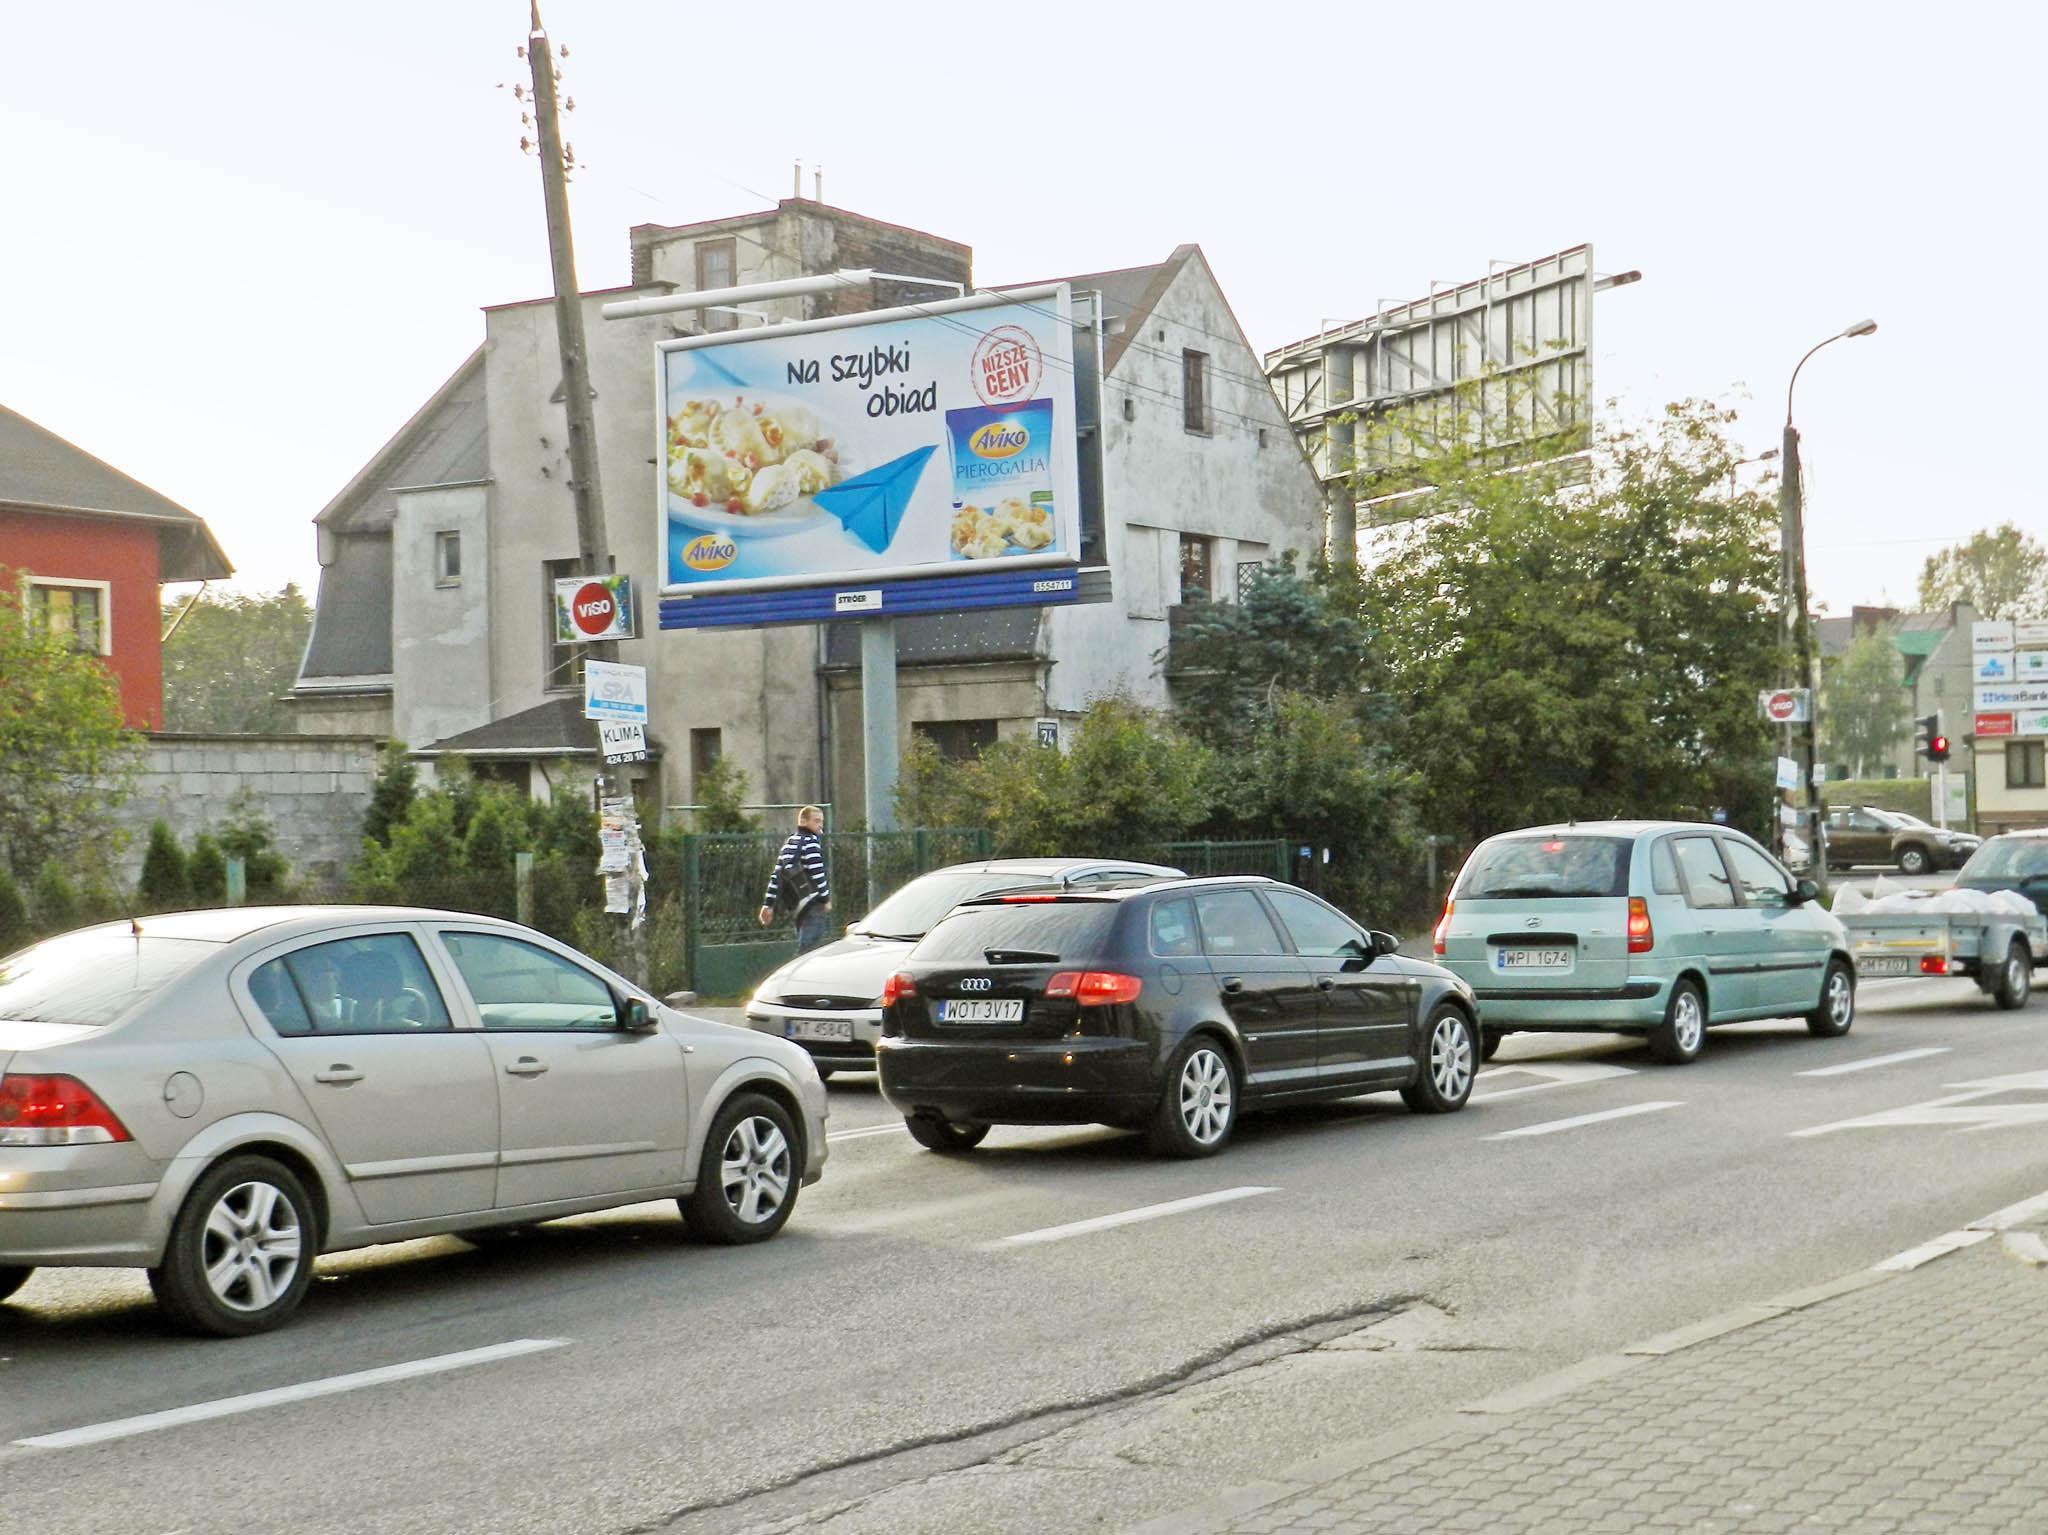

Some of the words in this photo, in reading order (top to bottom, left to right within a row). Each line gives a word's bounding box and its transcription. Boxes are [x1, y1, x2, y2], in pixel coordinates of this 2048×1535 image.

[787, 359, 820, 384] Na
[830, 340, 910, 390] szybki
[982, 344, 1028, 374] NIŻSZE
[986, 361, 1029, 396] CENY
[866, 381, 937, 417] obiad
[976, 427, 1026, 449] Aviko
[956, 458, 1046, 479] PIEROGALIA
[687, 540, 735, 561] Aviko
[603, 726, 641, 743] KLIMA
[606, 755, 622, 765] 424
[623, 753, 634, 763] 20
[1506, 952, 1530, 965] WPI
[1537, 952, 1568, 965] 1G74
[948, 1001, 978, 1019] WOT
[983, 1001, 1020, 1019] 3V17
